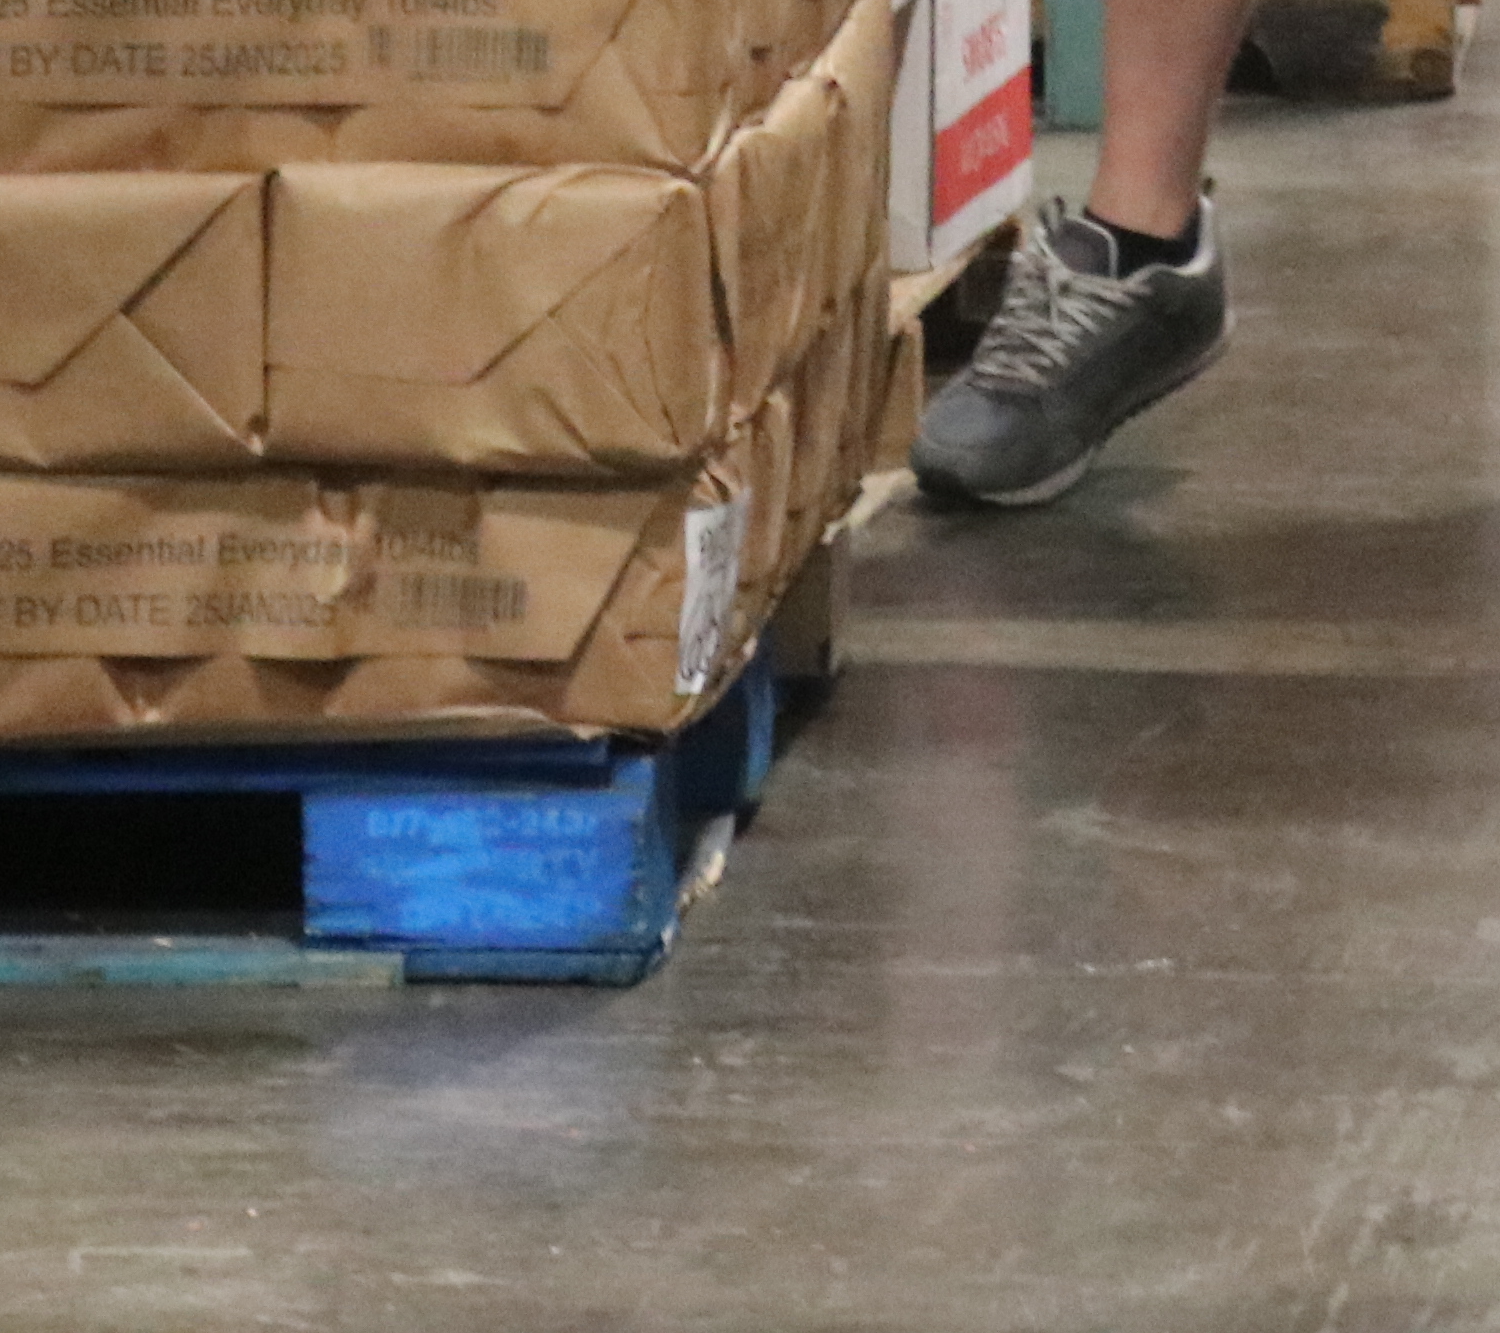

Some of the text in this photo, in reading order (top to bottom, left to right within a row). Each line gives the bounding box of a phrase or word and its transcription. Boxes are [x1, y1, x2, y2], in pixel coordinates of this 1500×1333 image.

[9, 45, 60, 78] BY
[71, 43, 167, 78] DATE
[49, 536, 206, 569] Essential
[13, 595, 62, 629] BY
[73, 593, 174, 627] DATE
